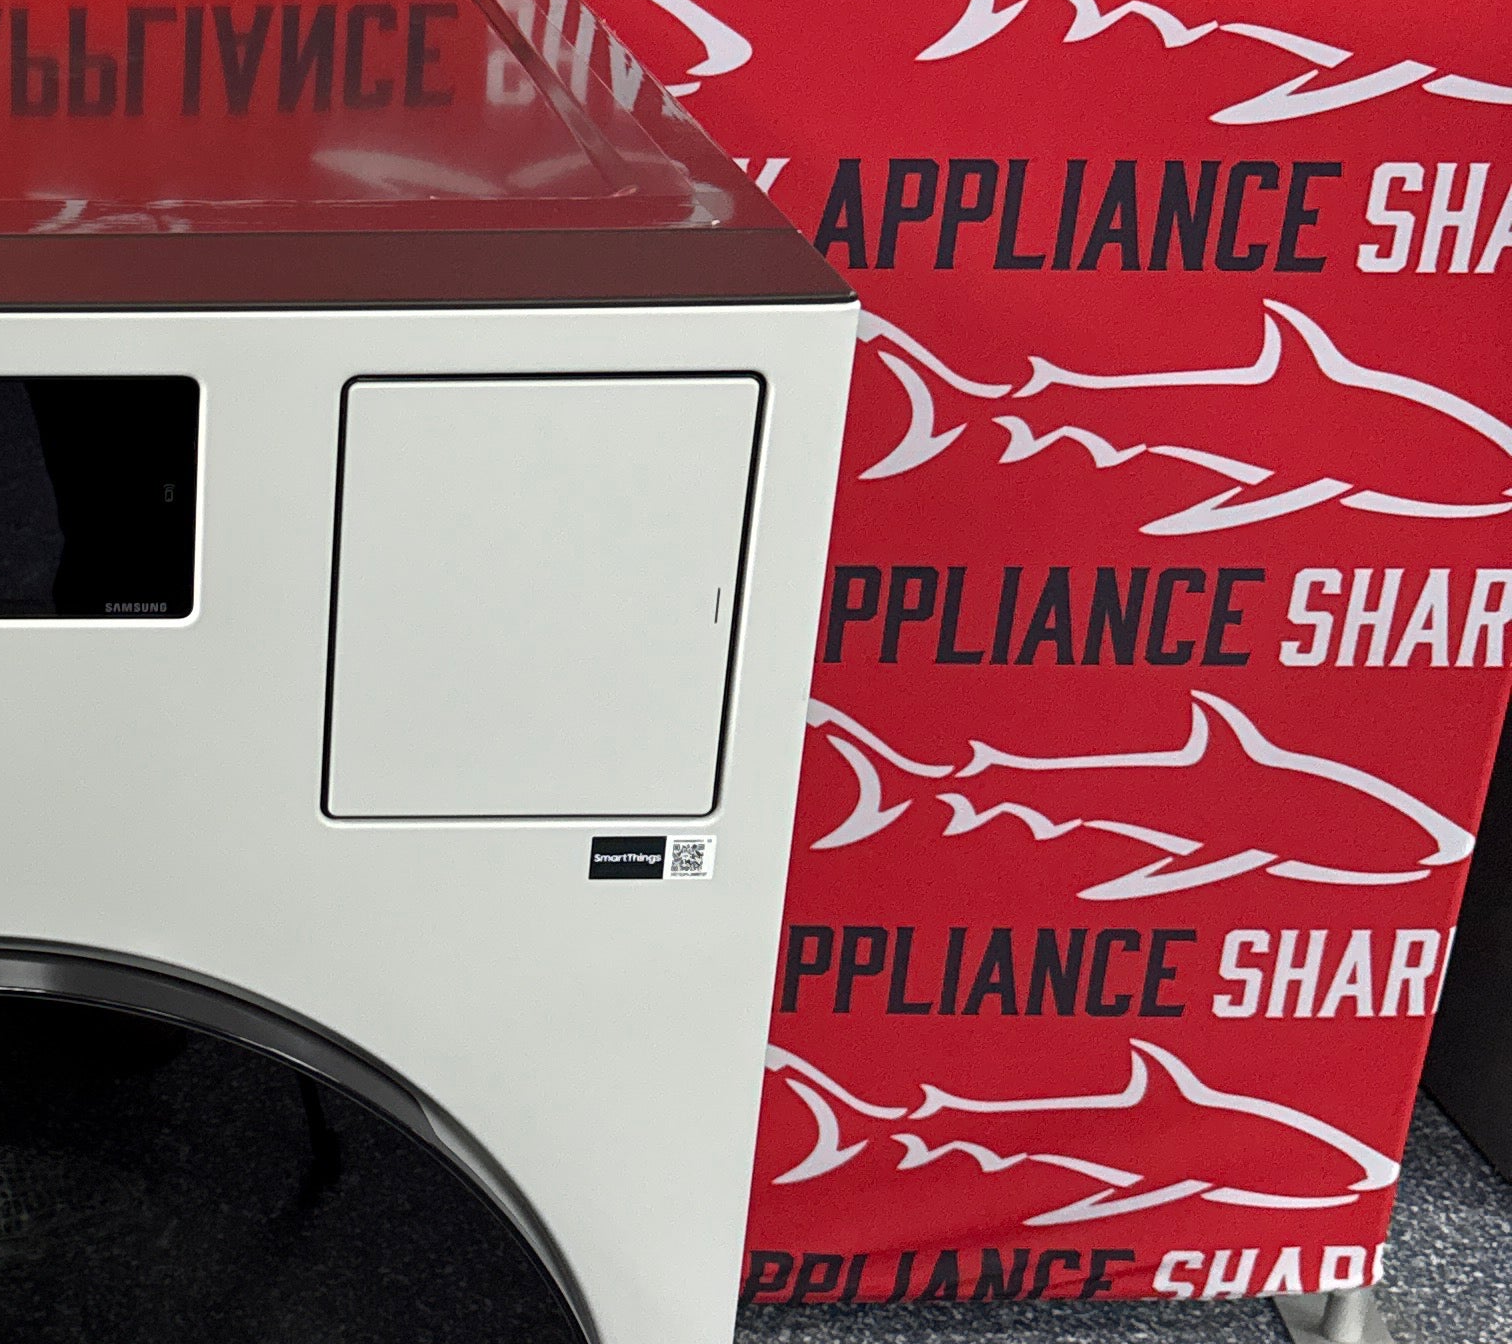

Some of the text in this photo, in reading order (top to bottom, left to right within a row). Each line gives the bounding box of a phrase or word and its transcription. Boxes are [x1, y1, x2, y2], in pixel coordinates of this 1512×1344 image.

[813, 159, 1341, 272] APPLIANCE
[105, 602, 167, 613] SAMSUNG
[824, 565, 1264, 666] PPLIANCE
[594, 853, 662, 864] SmartThings
[781, 925, 1456, 1017] PPLIANCE SHAR
